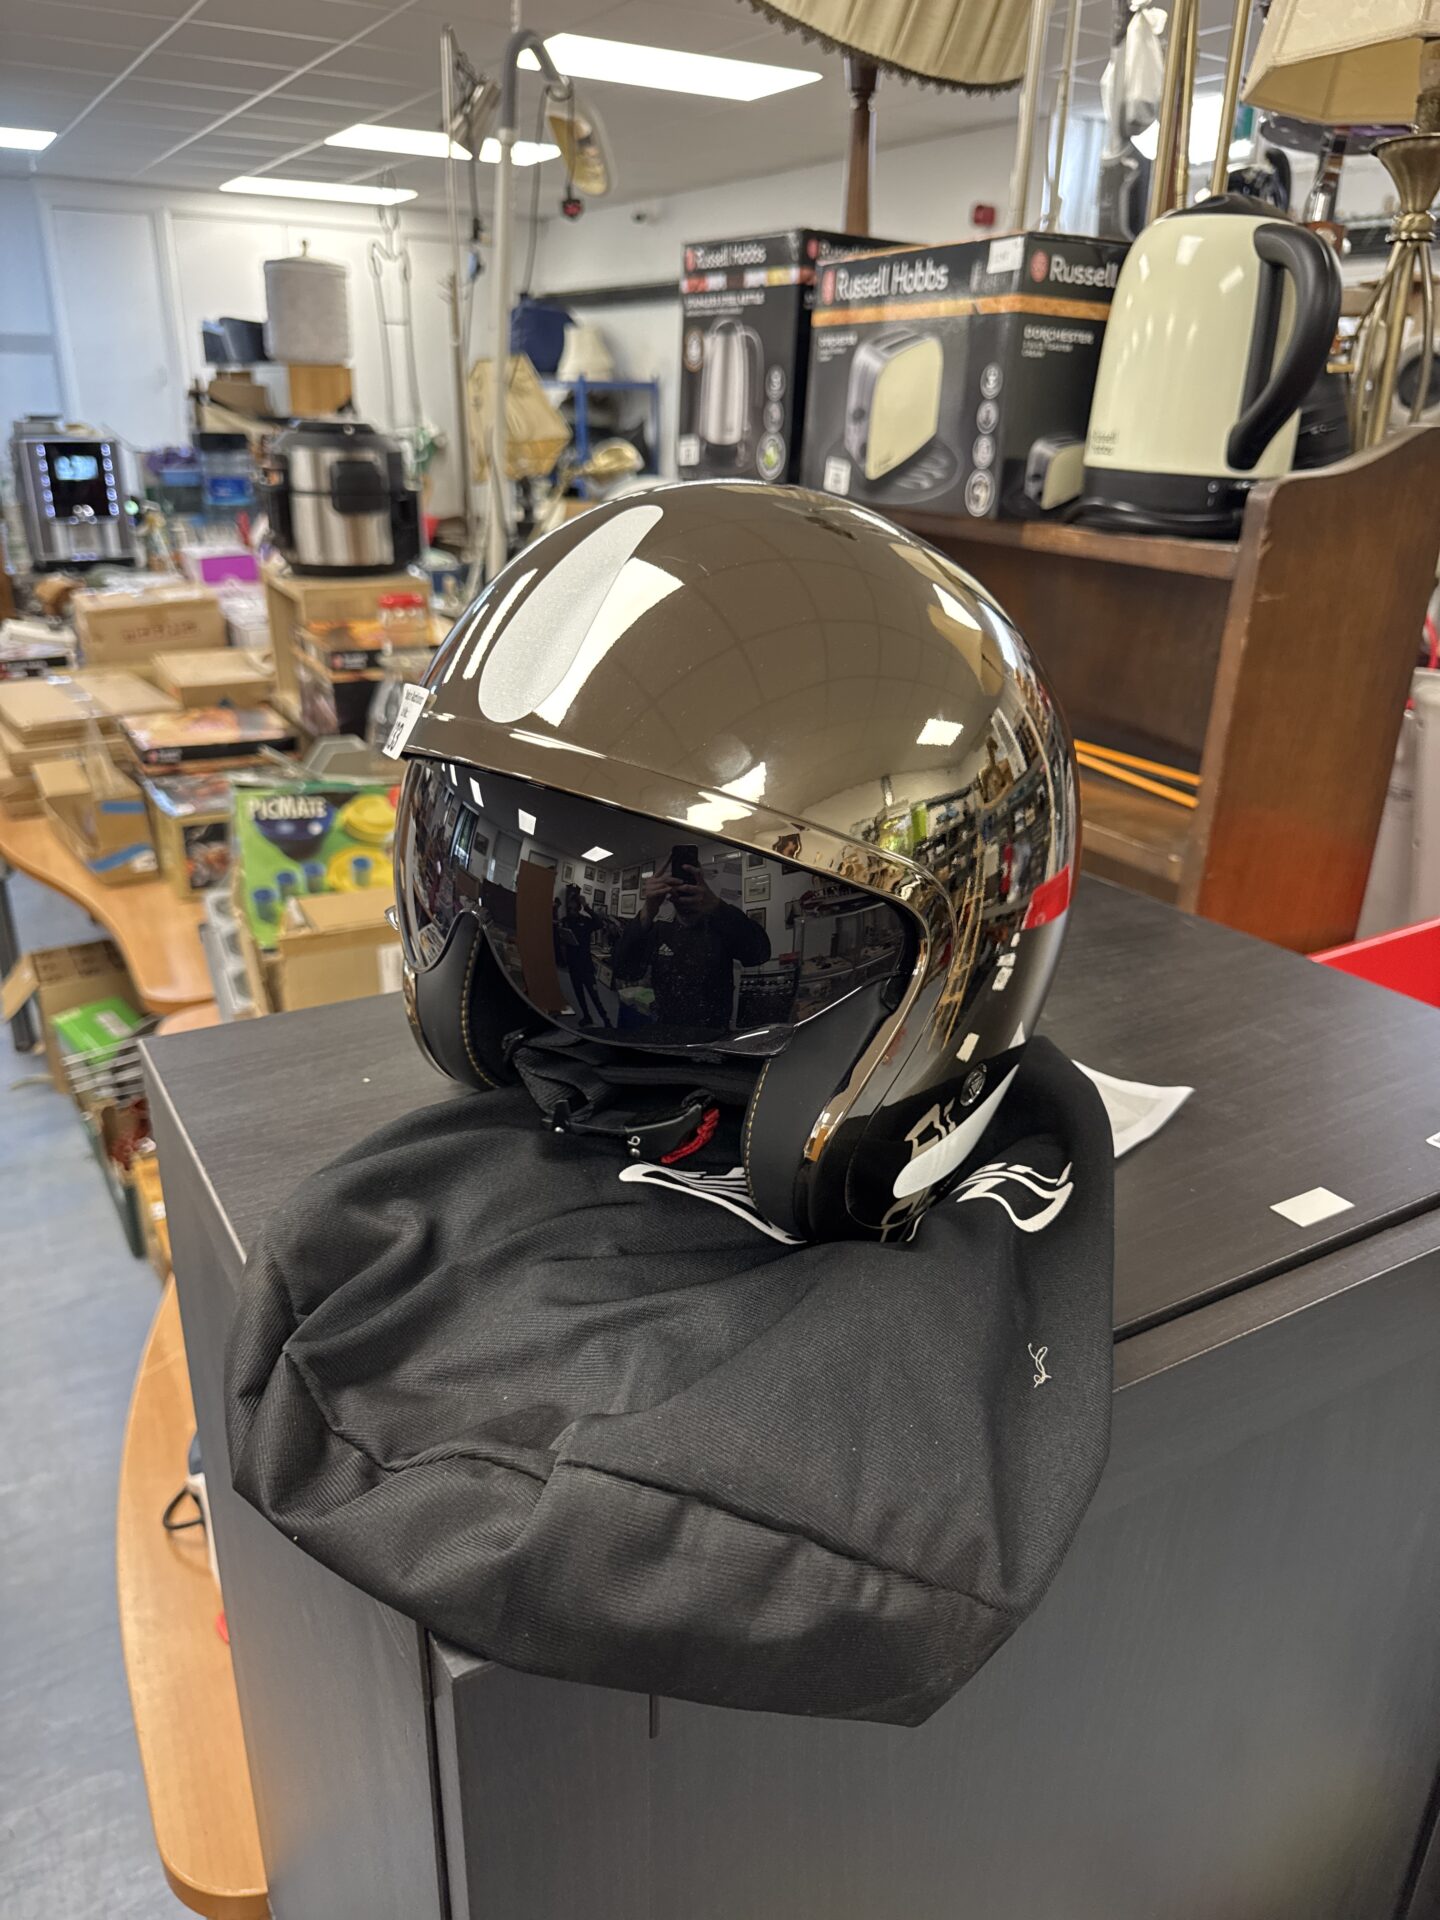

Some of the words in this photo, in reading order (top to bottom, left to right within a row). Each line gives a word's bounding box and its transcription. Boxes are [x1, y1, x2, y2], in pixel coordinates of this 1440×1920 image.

[836, 262, 890, 300] Russell
[891, 256, 949, 295] Hobbs
[1049, 253, 1118, 288] Russell
